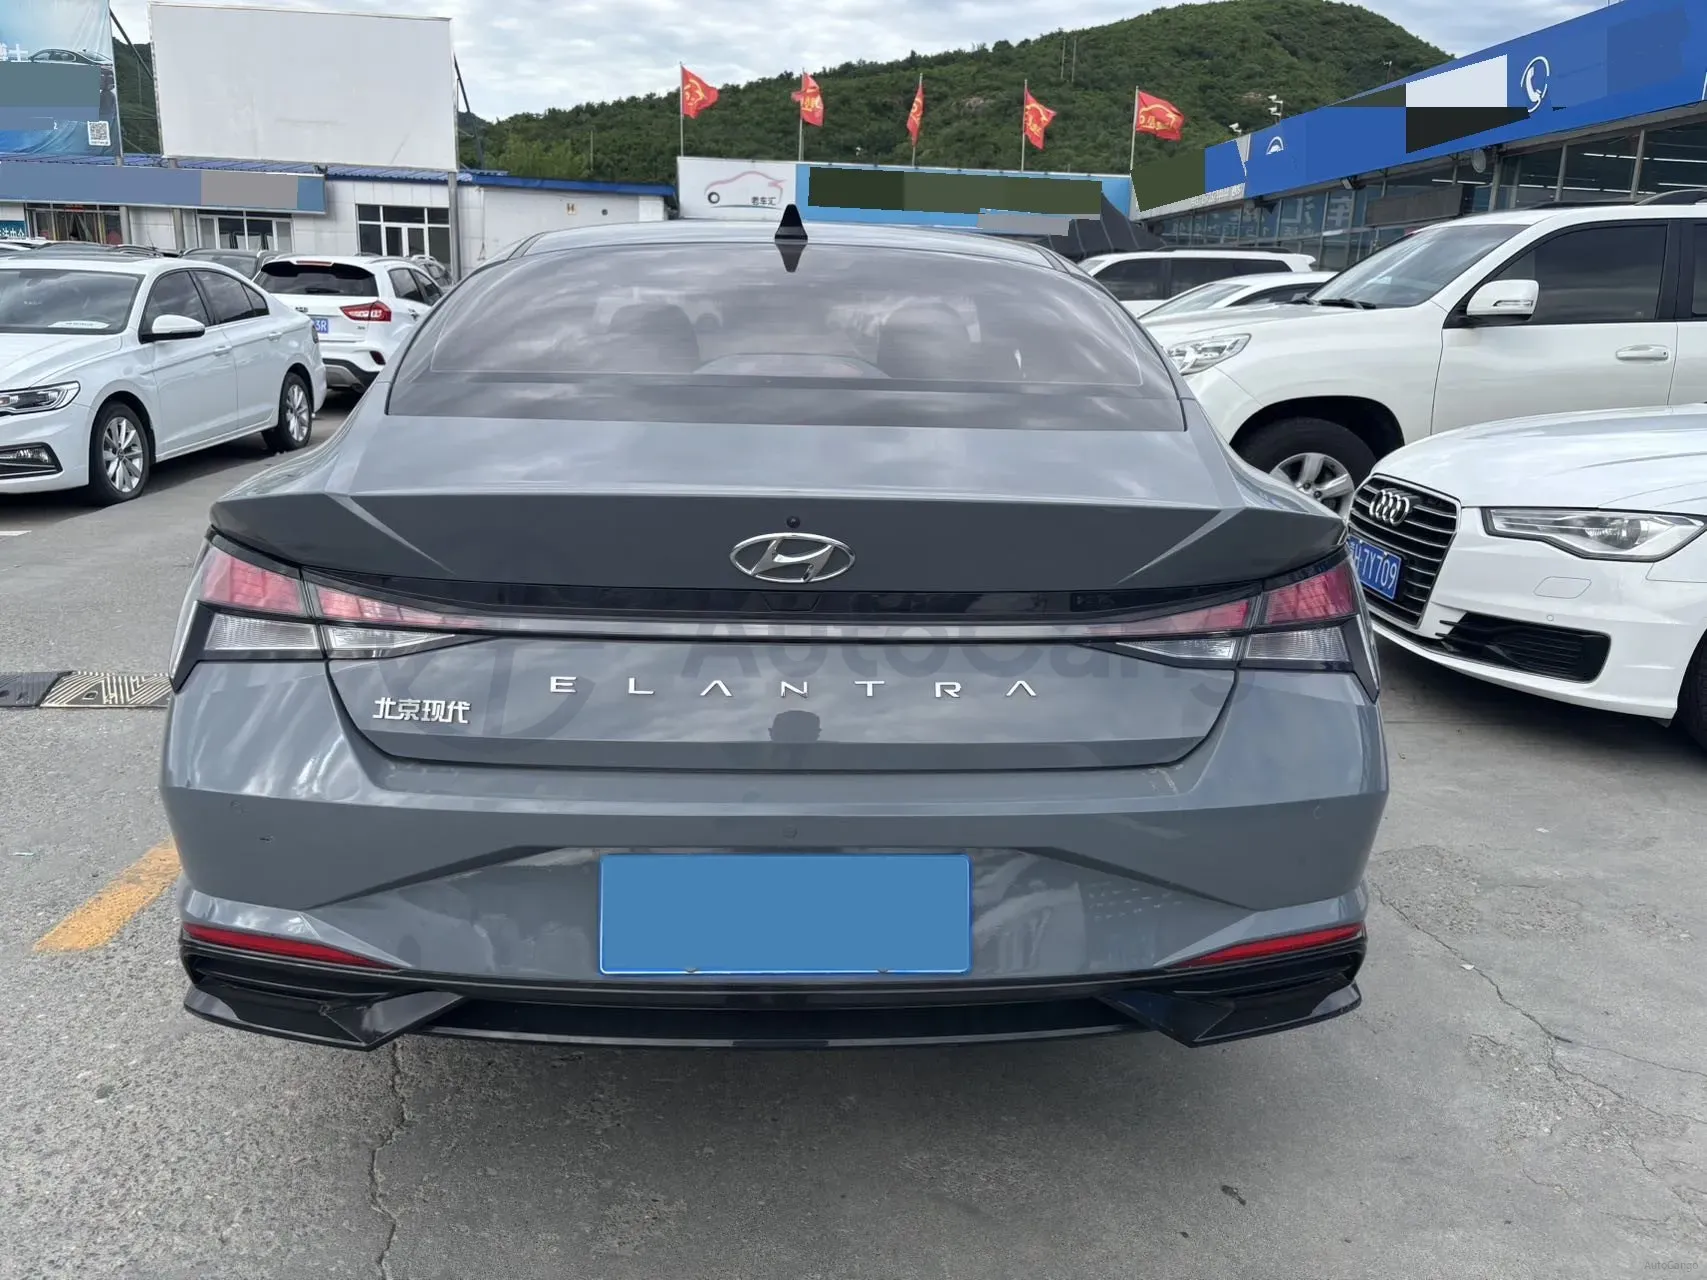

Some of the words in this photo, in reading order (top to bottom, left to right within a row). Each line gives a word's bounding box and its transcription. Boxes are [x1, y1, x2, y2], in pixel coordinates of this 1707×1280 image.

[549, 675, 1037, 699] ELANTRA
[372, 696, 471, 724] 北京现代
